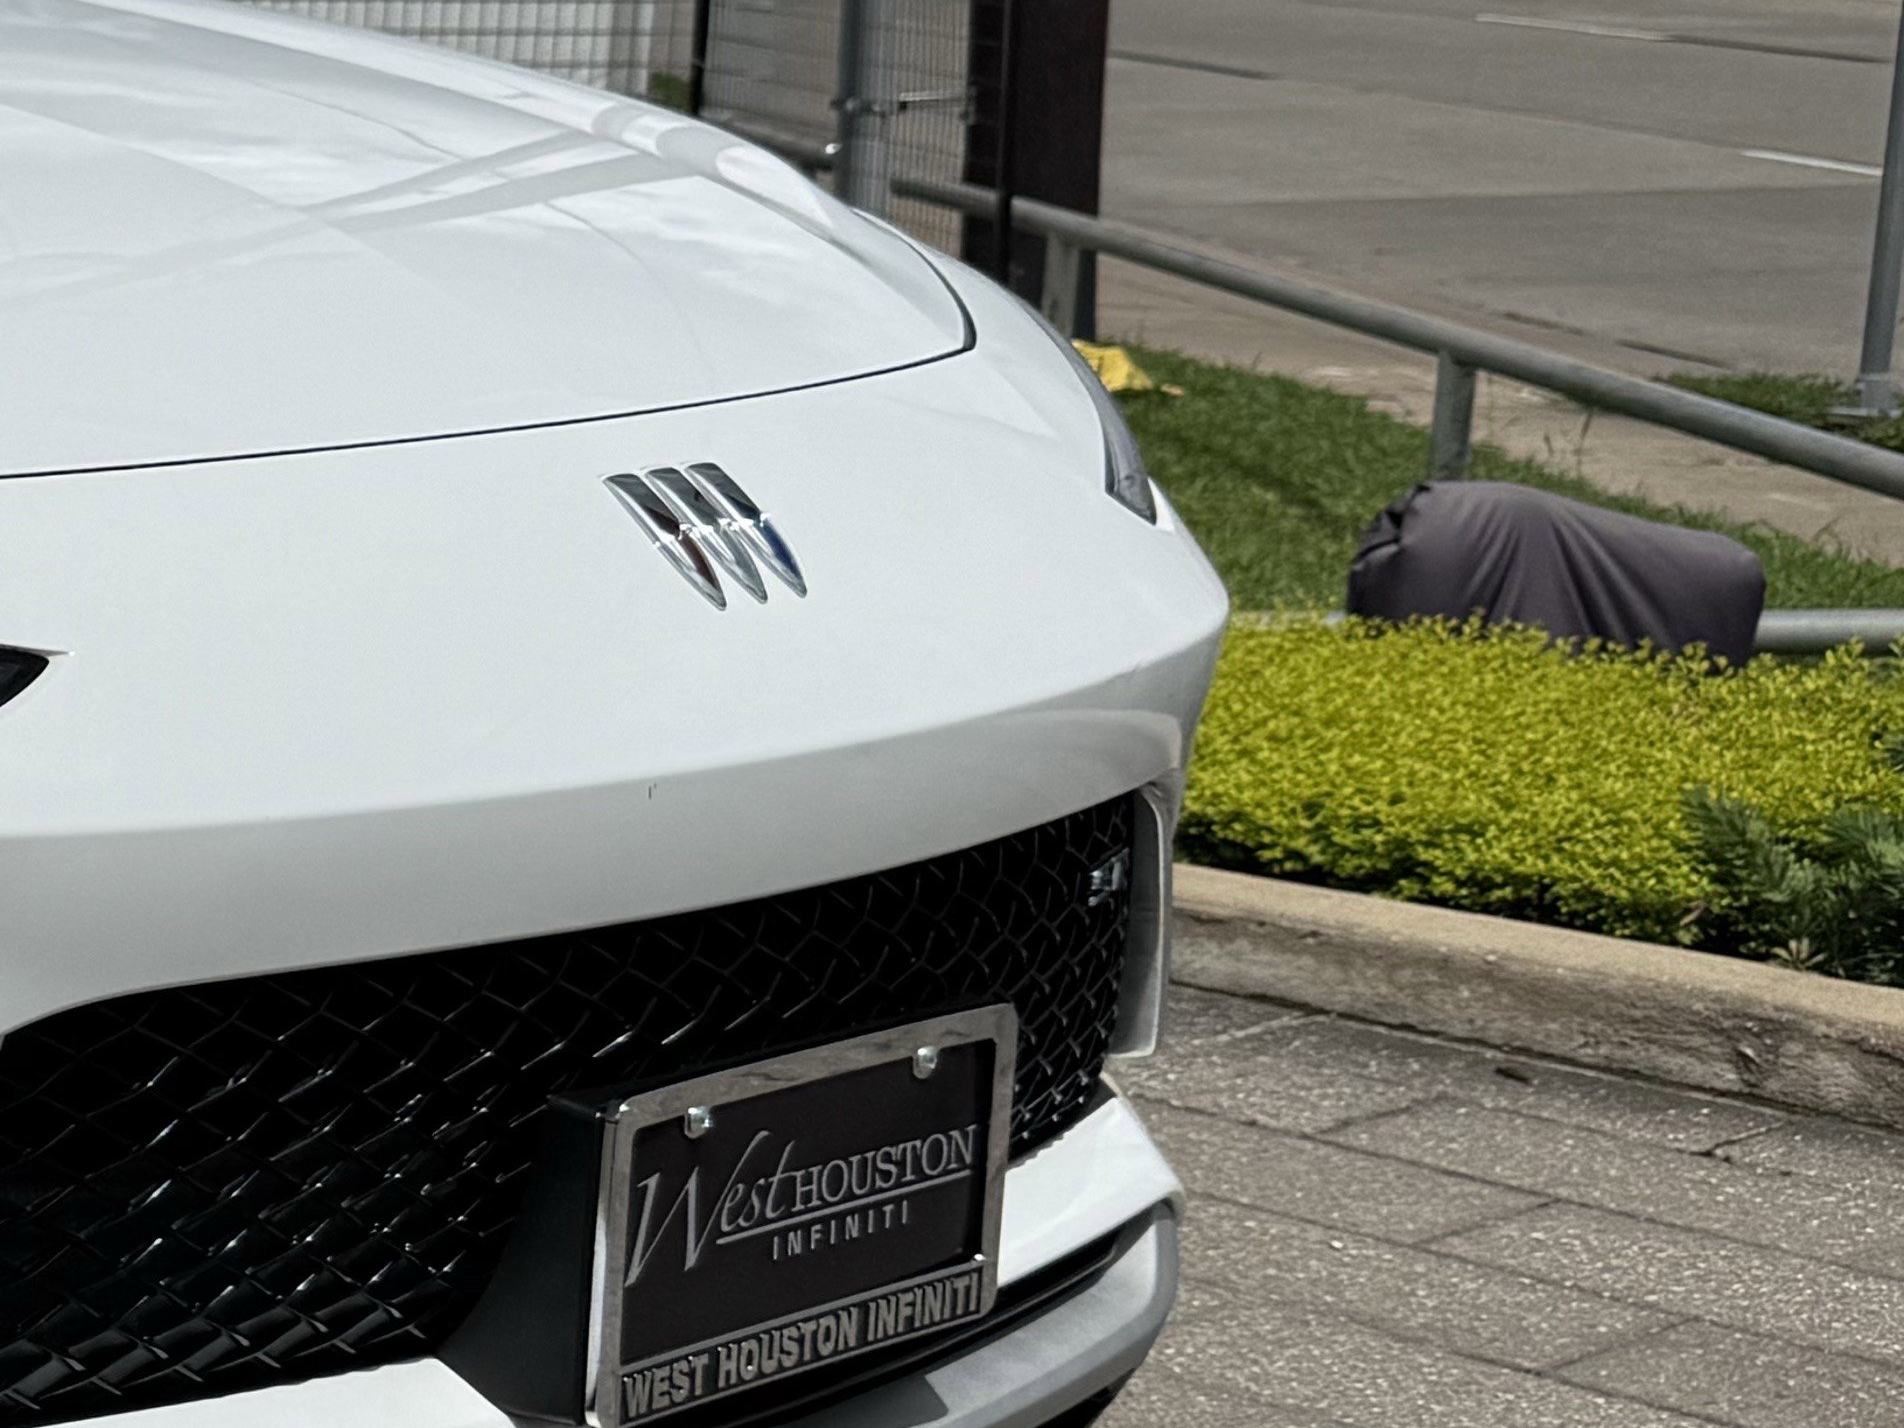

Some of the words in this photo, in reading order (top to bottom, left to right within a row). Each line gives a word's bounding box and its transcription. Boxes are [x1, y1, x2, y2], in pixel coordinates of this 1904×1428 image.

[624, 1130, 795, 1288] West
[792, 1124, 978, 1212] HOUSTON
[772, 1199, 909, 1261] INFINITI
[623, 1353, 709, 1418] WEST
[717, 1307, 859, 1389] HOUSTON
[867, 1272, 979, 1342] INFINITI
